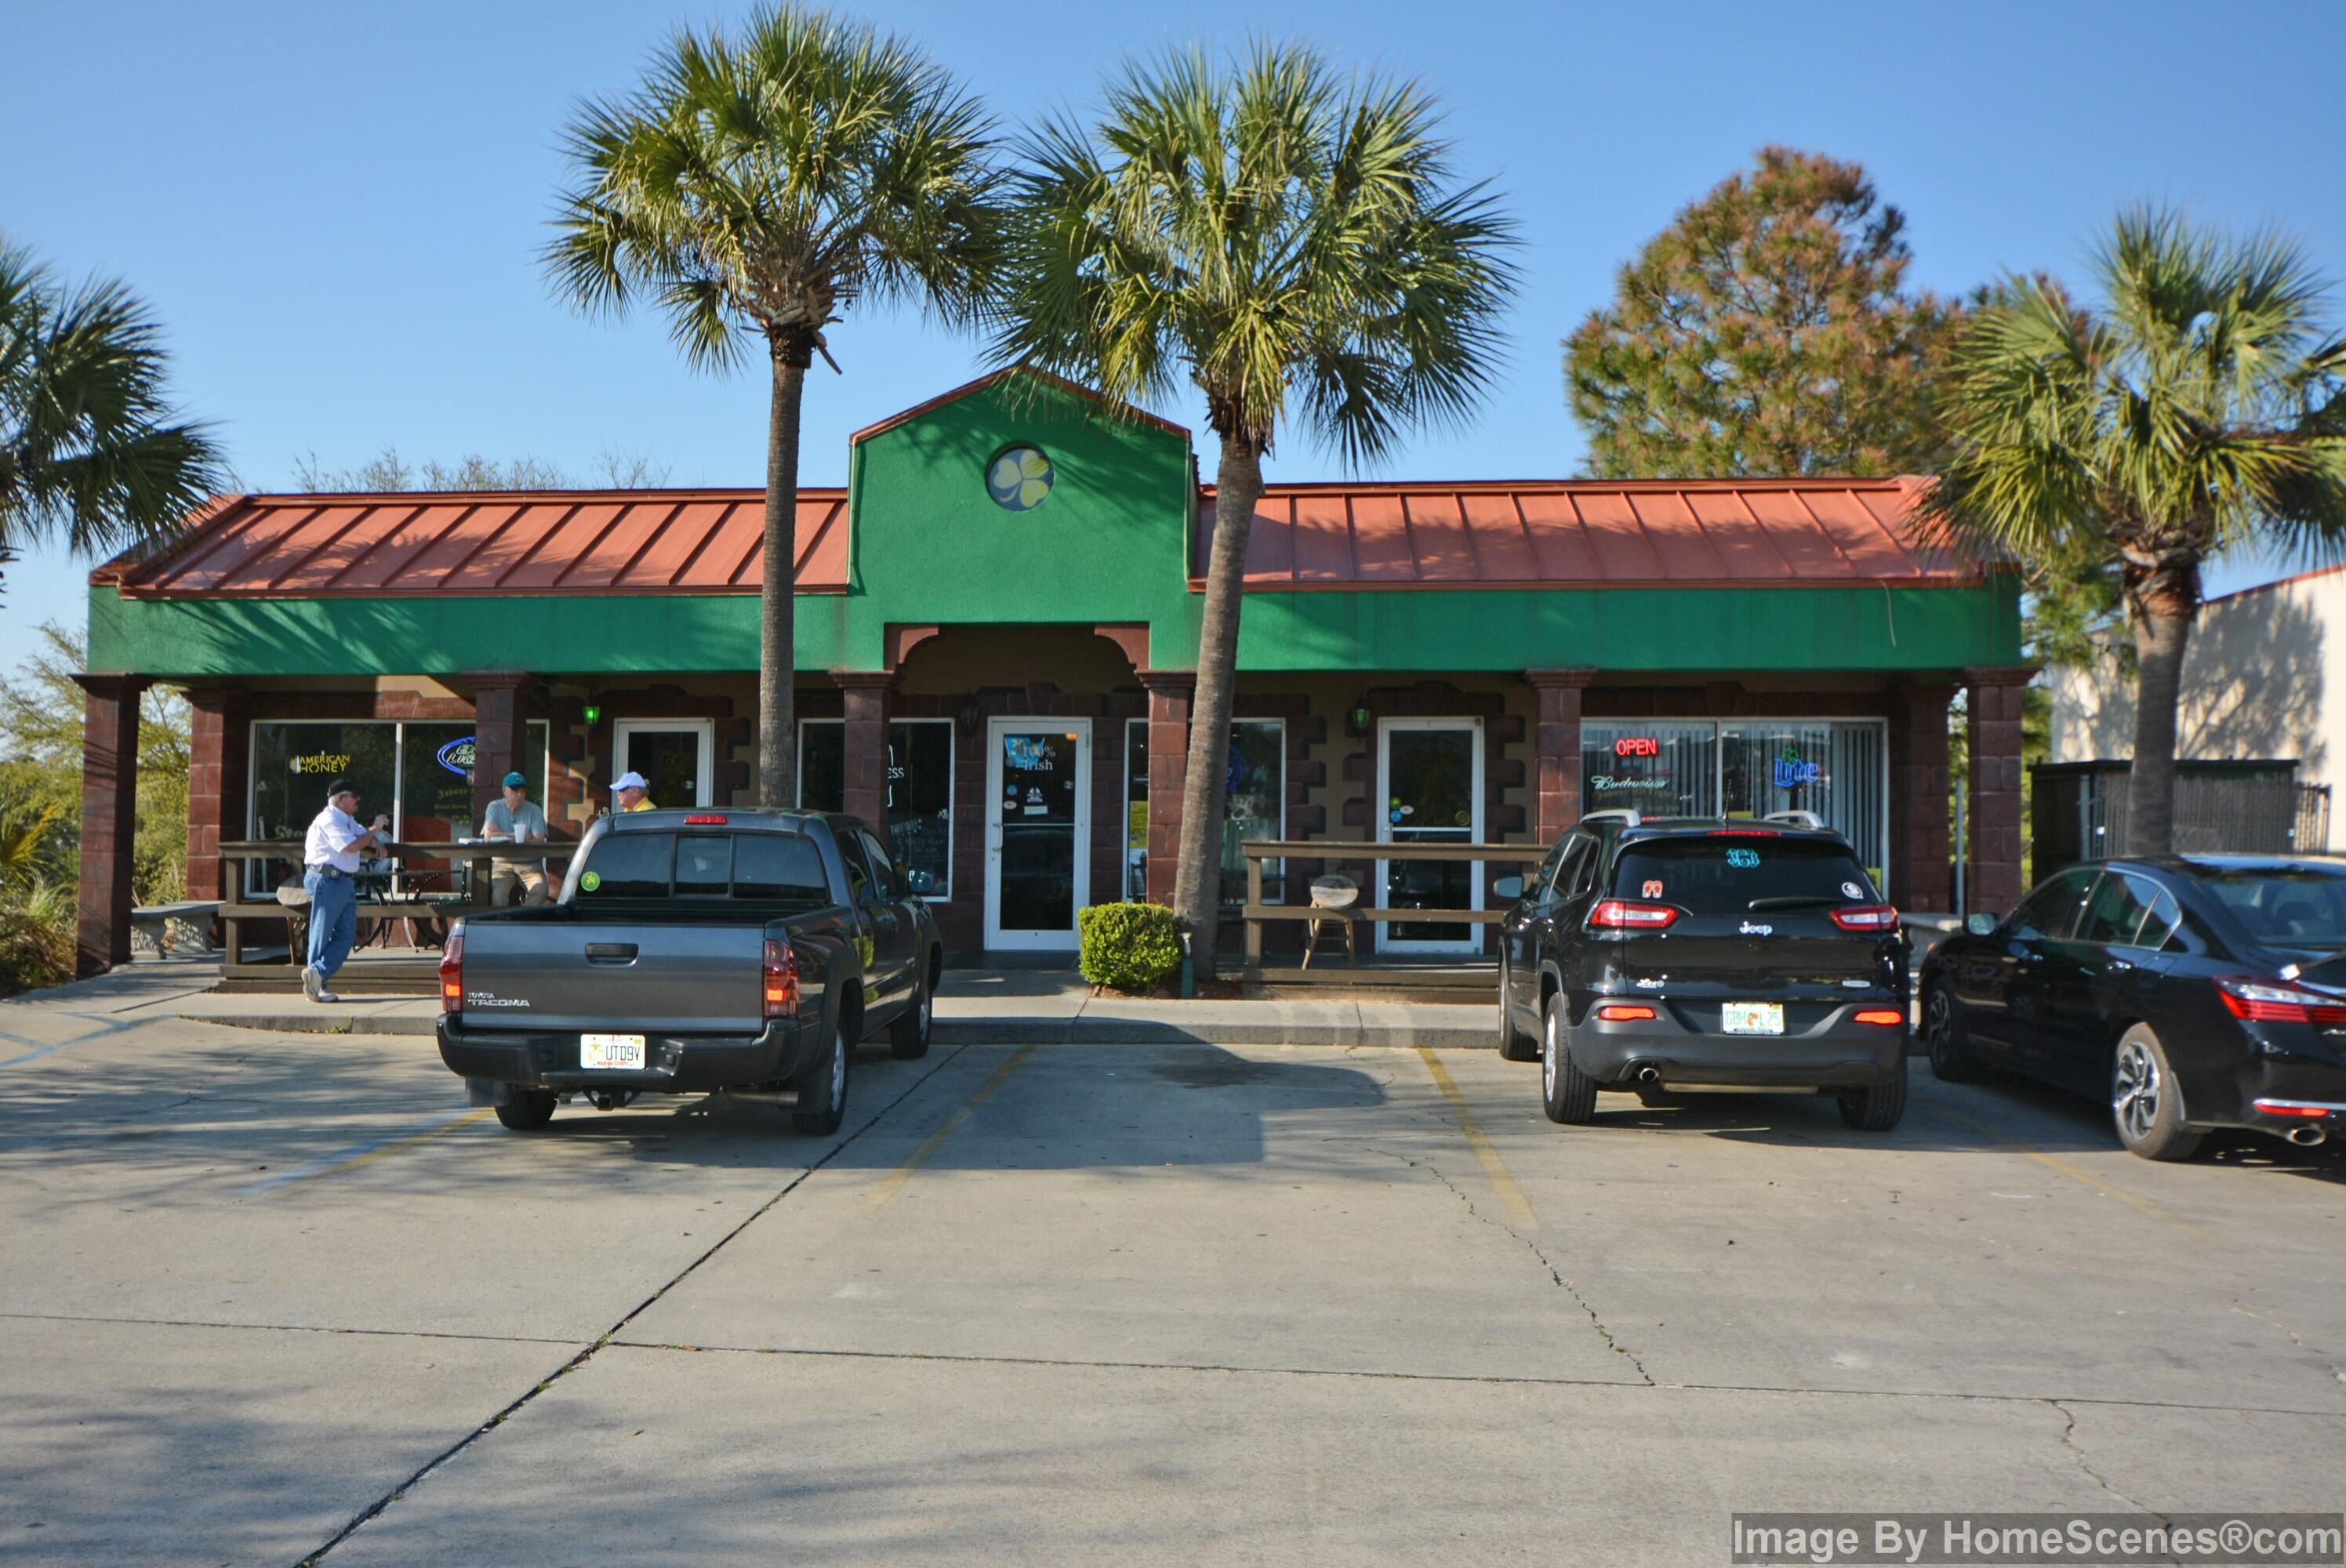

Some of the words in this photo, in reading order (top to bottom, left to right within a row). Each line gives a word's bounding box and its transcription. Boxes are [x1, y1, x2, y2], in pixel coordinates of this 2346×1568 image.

[1616, 739, 1657, 756] OPEN
[300, 755, 350, 765] AMERICAN
[1024, 758, 1053, 771] Irish
[300, 764, 347, 774] HONEY
[1774, 758, 1820, 787] Lite
[1591, 775, 1669, 790] Budweiser
[1739, 921, 1773, 936] Jeep
